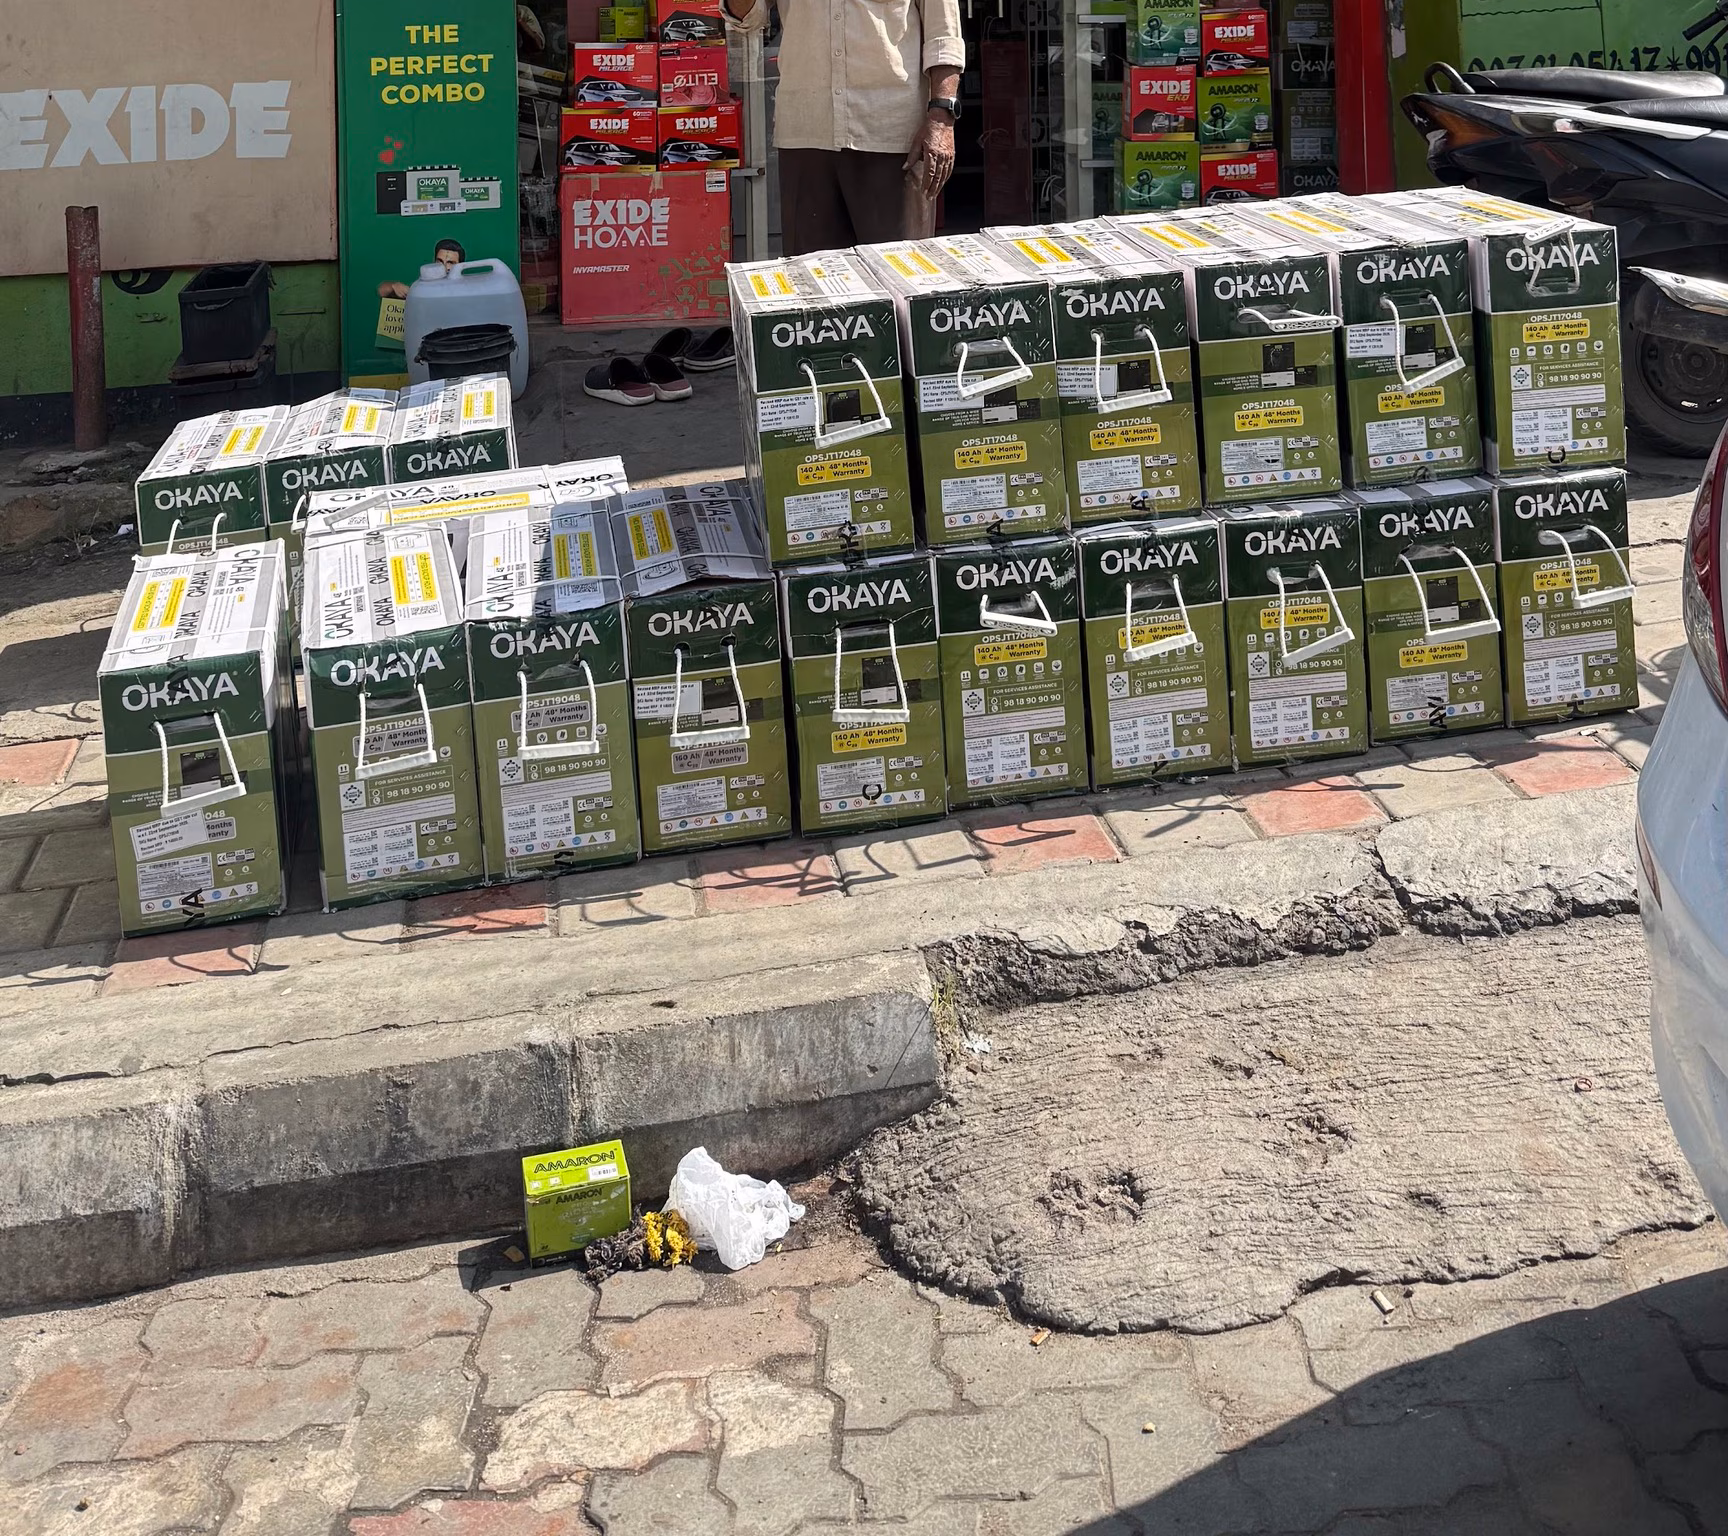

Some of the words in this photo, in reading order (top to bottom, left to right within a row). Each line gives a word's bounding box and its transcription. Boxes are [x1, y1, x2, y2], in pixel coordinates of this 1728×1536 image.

[405, 24, 459, 44] THE
[1214, 25, 1255, 38] EXIDE
[371, 53, 494, 76] PERFECT
[593, 54, 635, 67] EXIDE
[381, 82, 485, 105] COMBO
[1139, 80, 1191, 95] EXIDE
[1208, 83, 1258, 96] AMARON
[0, 80, 292, 171] EXIDE
[590, 118, 630, 130] EXIDE
[676, 116, 718, 130] EXIDE
[1135, 150, 1187, 162] AMARON
[418, 177, 447, 187] OKAYA
[1217, 163, 1257, 177] EXIDE
[573, 197, 670, 226] EXIDE
[573, 225, 669, 249] HOME
[573, 264, 630, 274] INVAMASTER
[1356, 253, 1450, 284] OKAYA
[1505, 243, 1600, 272] OKAYA
[1213, 270, 1310, 300] OKAYA
[1066, 287, 1166, 320] OKAYA
[929, 299, 1031, 333] OKAYA
[1530, 312, 1582, 323] OPSJT17048
[771, 314, 875, 348] OKAYA
[1555, 329, 1584, 337] Warranty
[1242, 399, 1295, 410] OPSJT17048
[962, 434, 1018, 447] OPSJT17048
[407, 443, 493, 475] OKAYA
[805, 449, 862, 463] OPSJT17048
[842, 460, 868, 468] Months
[282, 459, 369, 490] OKAYA
[833, 468, 865, 477] Warranty
[154, 481, 243, 510] OKAYA
[1514, 489, 1610, 519] OKAYA
[1379, 506, 1475, 538] OKAYA
[1244, 527, 1342, 557] OKAYA
[1100, 543, 1199, 575] OKAYA
[956, 557, 1057, 590] OKAYA
[807, 578, 911, 614] OKAYA
[648, 603, 755, 637] OKAYA
[489, 621, 600, 660] OKAYA
[331, 645, 445, 687] OKAYA
[122, 672, 240, 711] OKAYA
[533, 1150, 615, 1174] AMARON
[555, 1188, 603, 1205] AMARON
